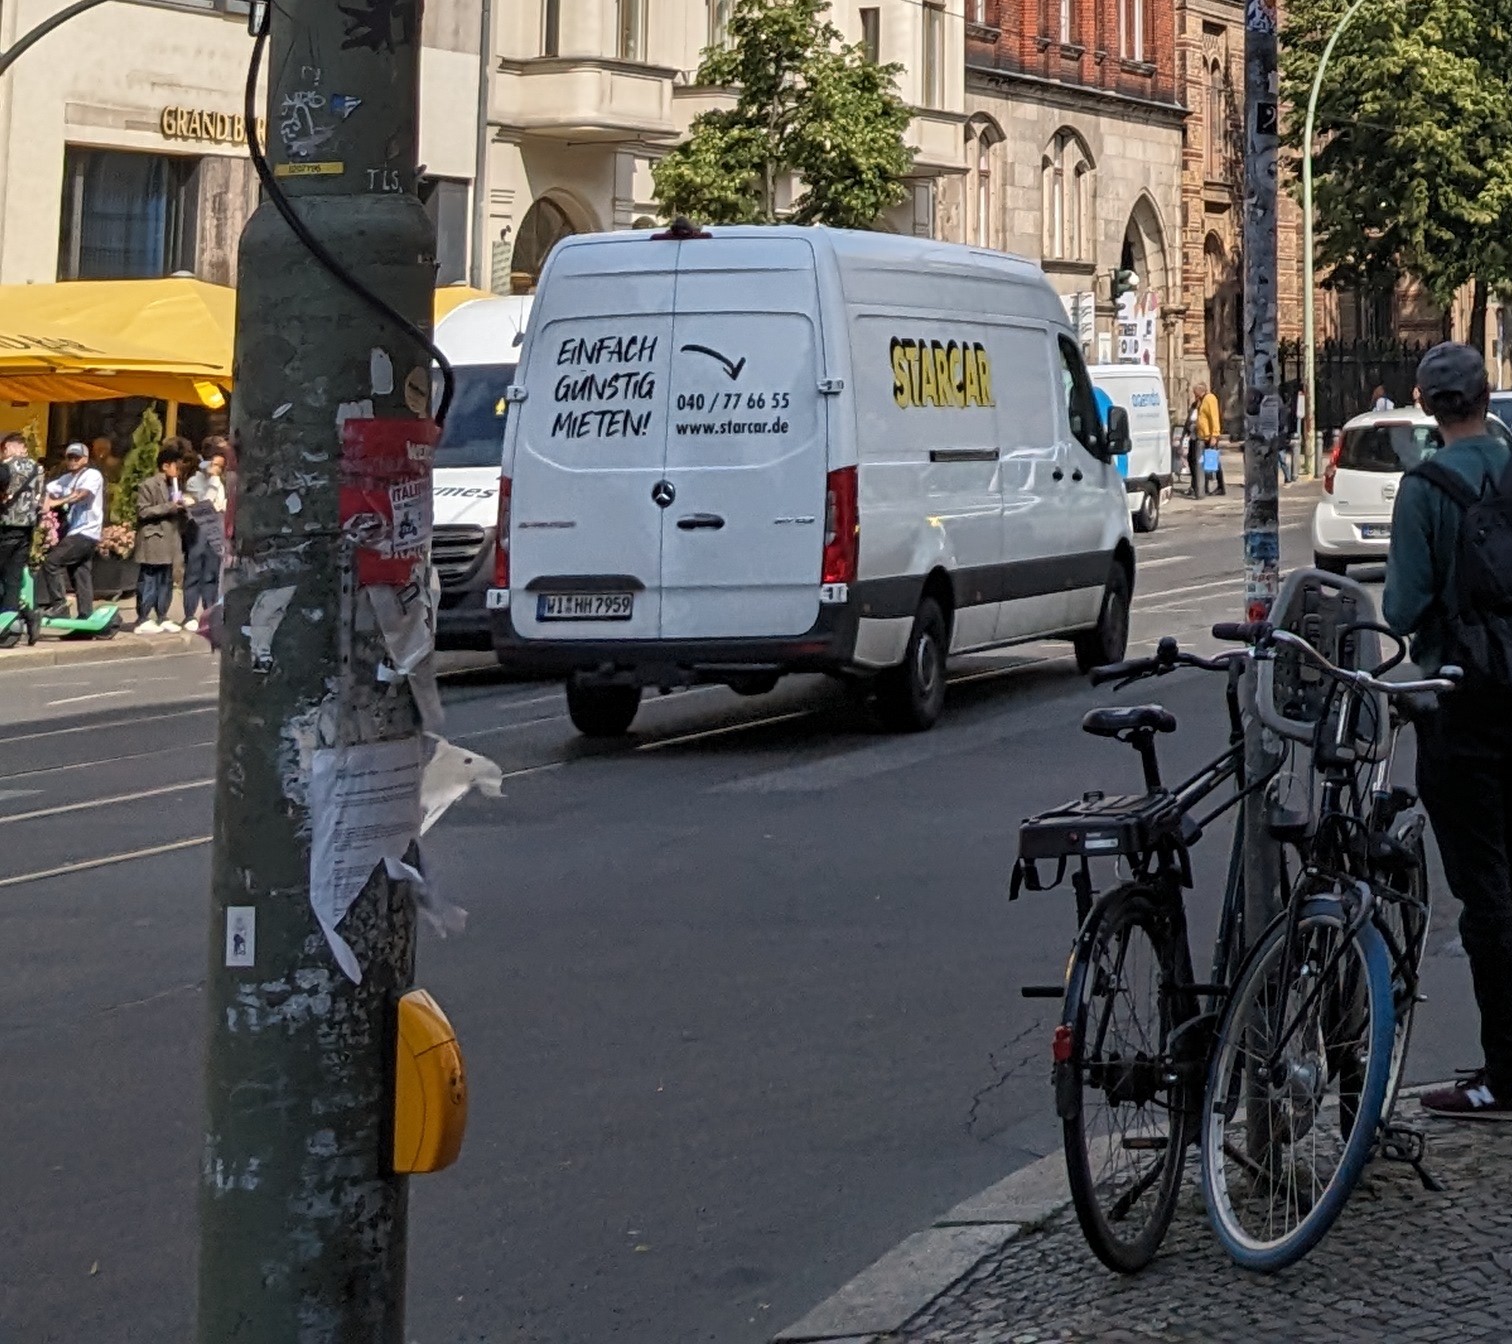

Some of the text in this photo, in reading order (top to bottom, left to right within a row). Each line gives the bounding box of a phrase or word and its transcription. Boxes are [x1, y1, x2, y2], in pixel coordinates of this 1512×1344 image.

[162, 105, 266, 144] GRAND BR
[890, 336, 996, 410] STARCAR
[676, 392, 790, 413] 040 / 77 66 55
[551, 409, 652, 439] MIETEN!
[675, 416, 789, 435] www.starcar.de
[596, 594, 631, 613] 7959
